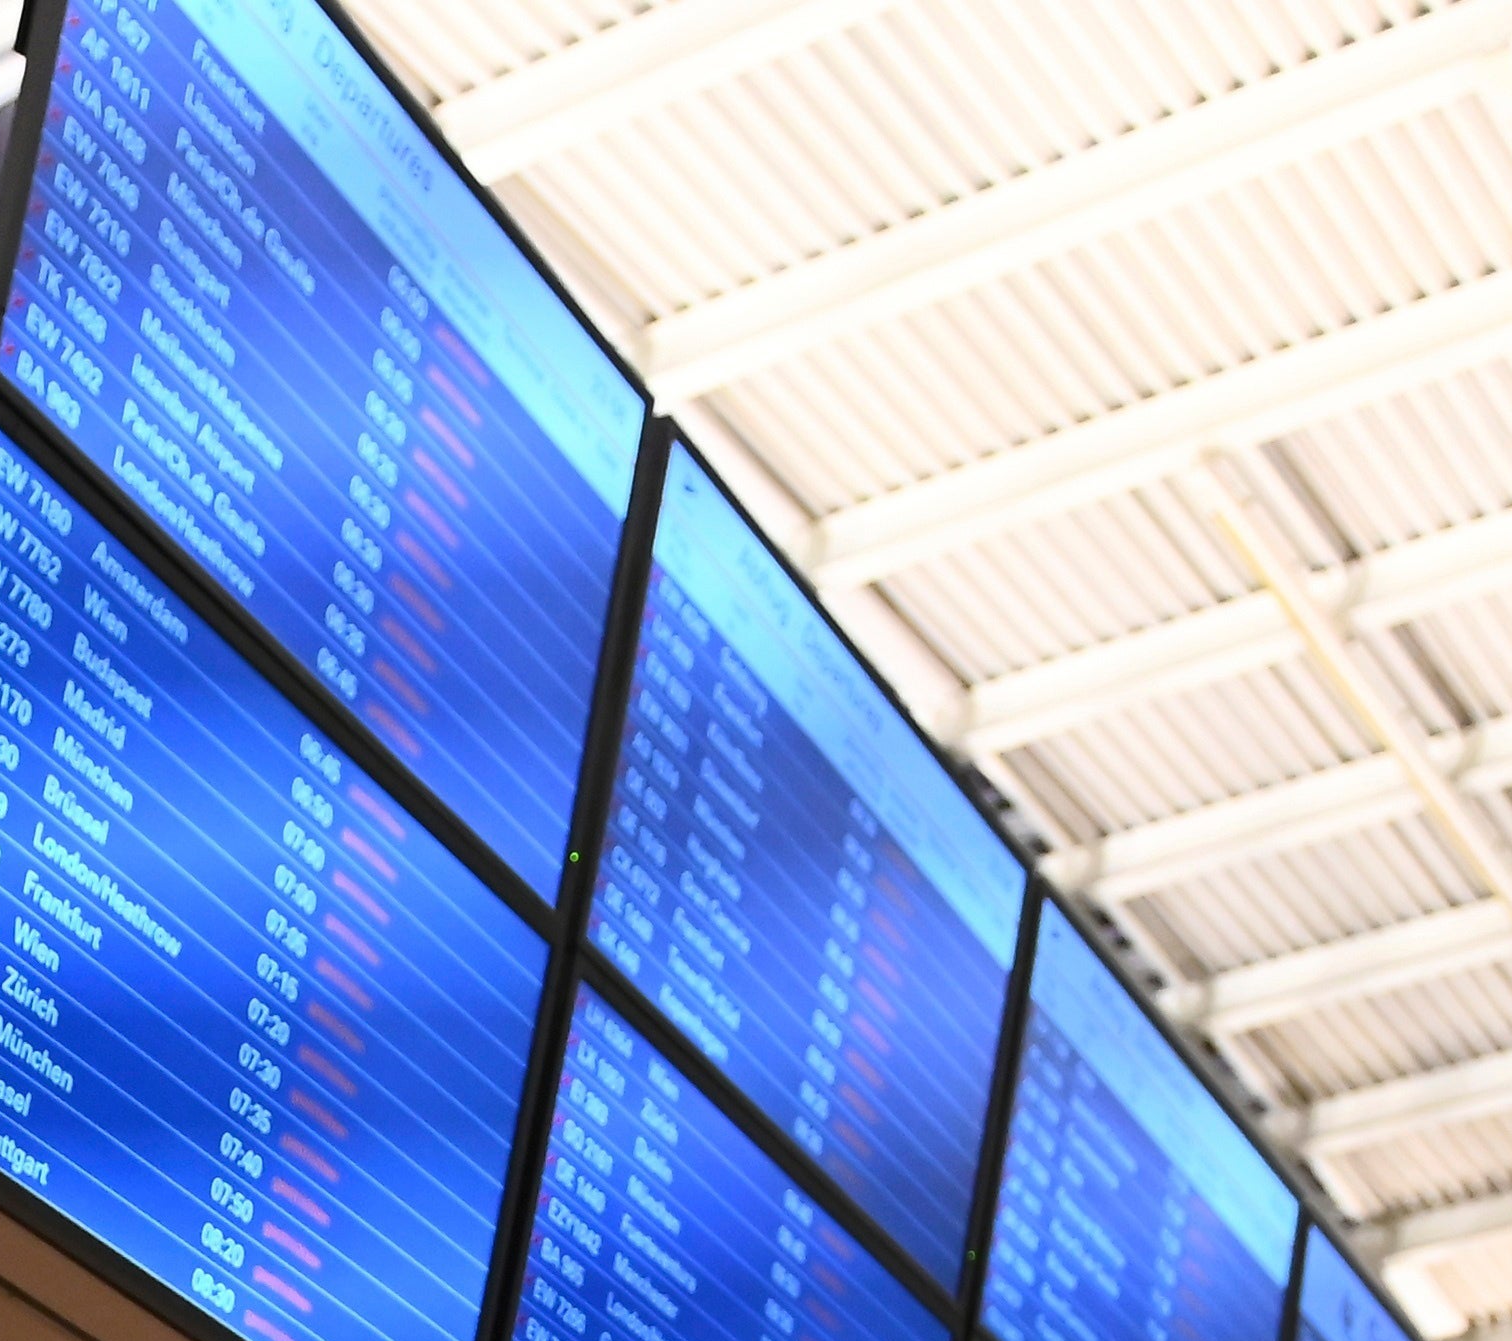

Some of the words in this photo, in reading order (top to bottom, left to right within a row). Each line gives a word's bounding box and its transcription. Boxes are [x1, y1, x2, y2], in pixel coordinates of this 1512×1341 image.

[62, 115, 97, 162] EW
[311, 33, 435, 194] Departures
[54, 162, 87, 208] EW
[44, 209, 78, 255] EW
[25, 303, 60, 350] EW
[16, 350, 44, 396] BA
[38, 255, 62, 300] TK
[196, 423, 254, 492] Airport
[18, 526, 61, 582] 7752
[84, 584, 127, 642] Wien
[28, 478, 71, 534] 7180
[91, 540, 187, 642] Amsterdam
[63, 679, 126, 751] Madrid
[73, 632, 152, 721] Budapest
[53, 726, 133, 812] München
[23, 869, 102, 949] Frankfurt
[32, 821, 181, 956] London/Heathrow
[43, 774, 109, 845] Brüssel
[256, 953, 298, 1001] 07:15
[14, 916, 59, 971] Wien
[1, 965, 58, 1026] Zürich
[220, 1132, 262, 1179] 07:40
[210, 1177, 253, 1223] 07:50
